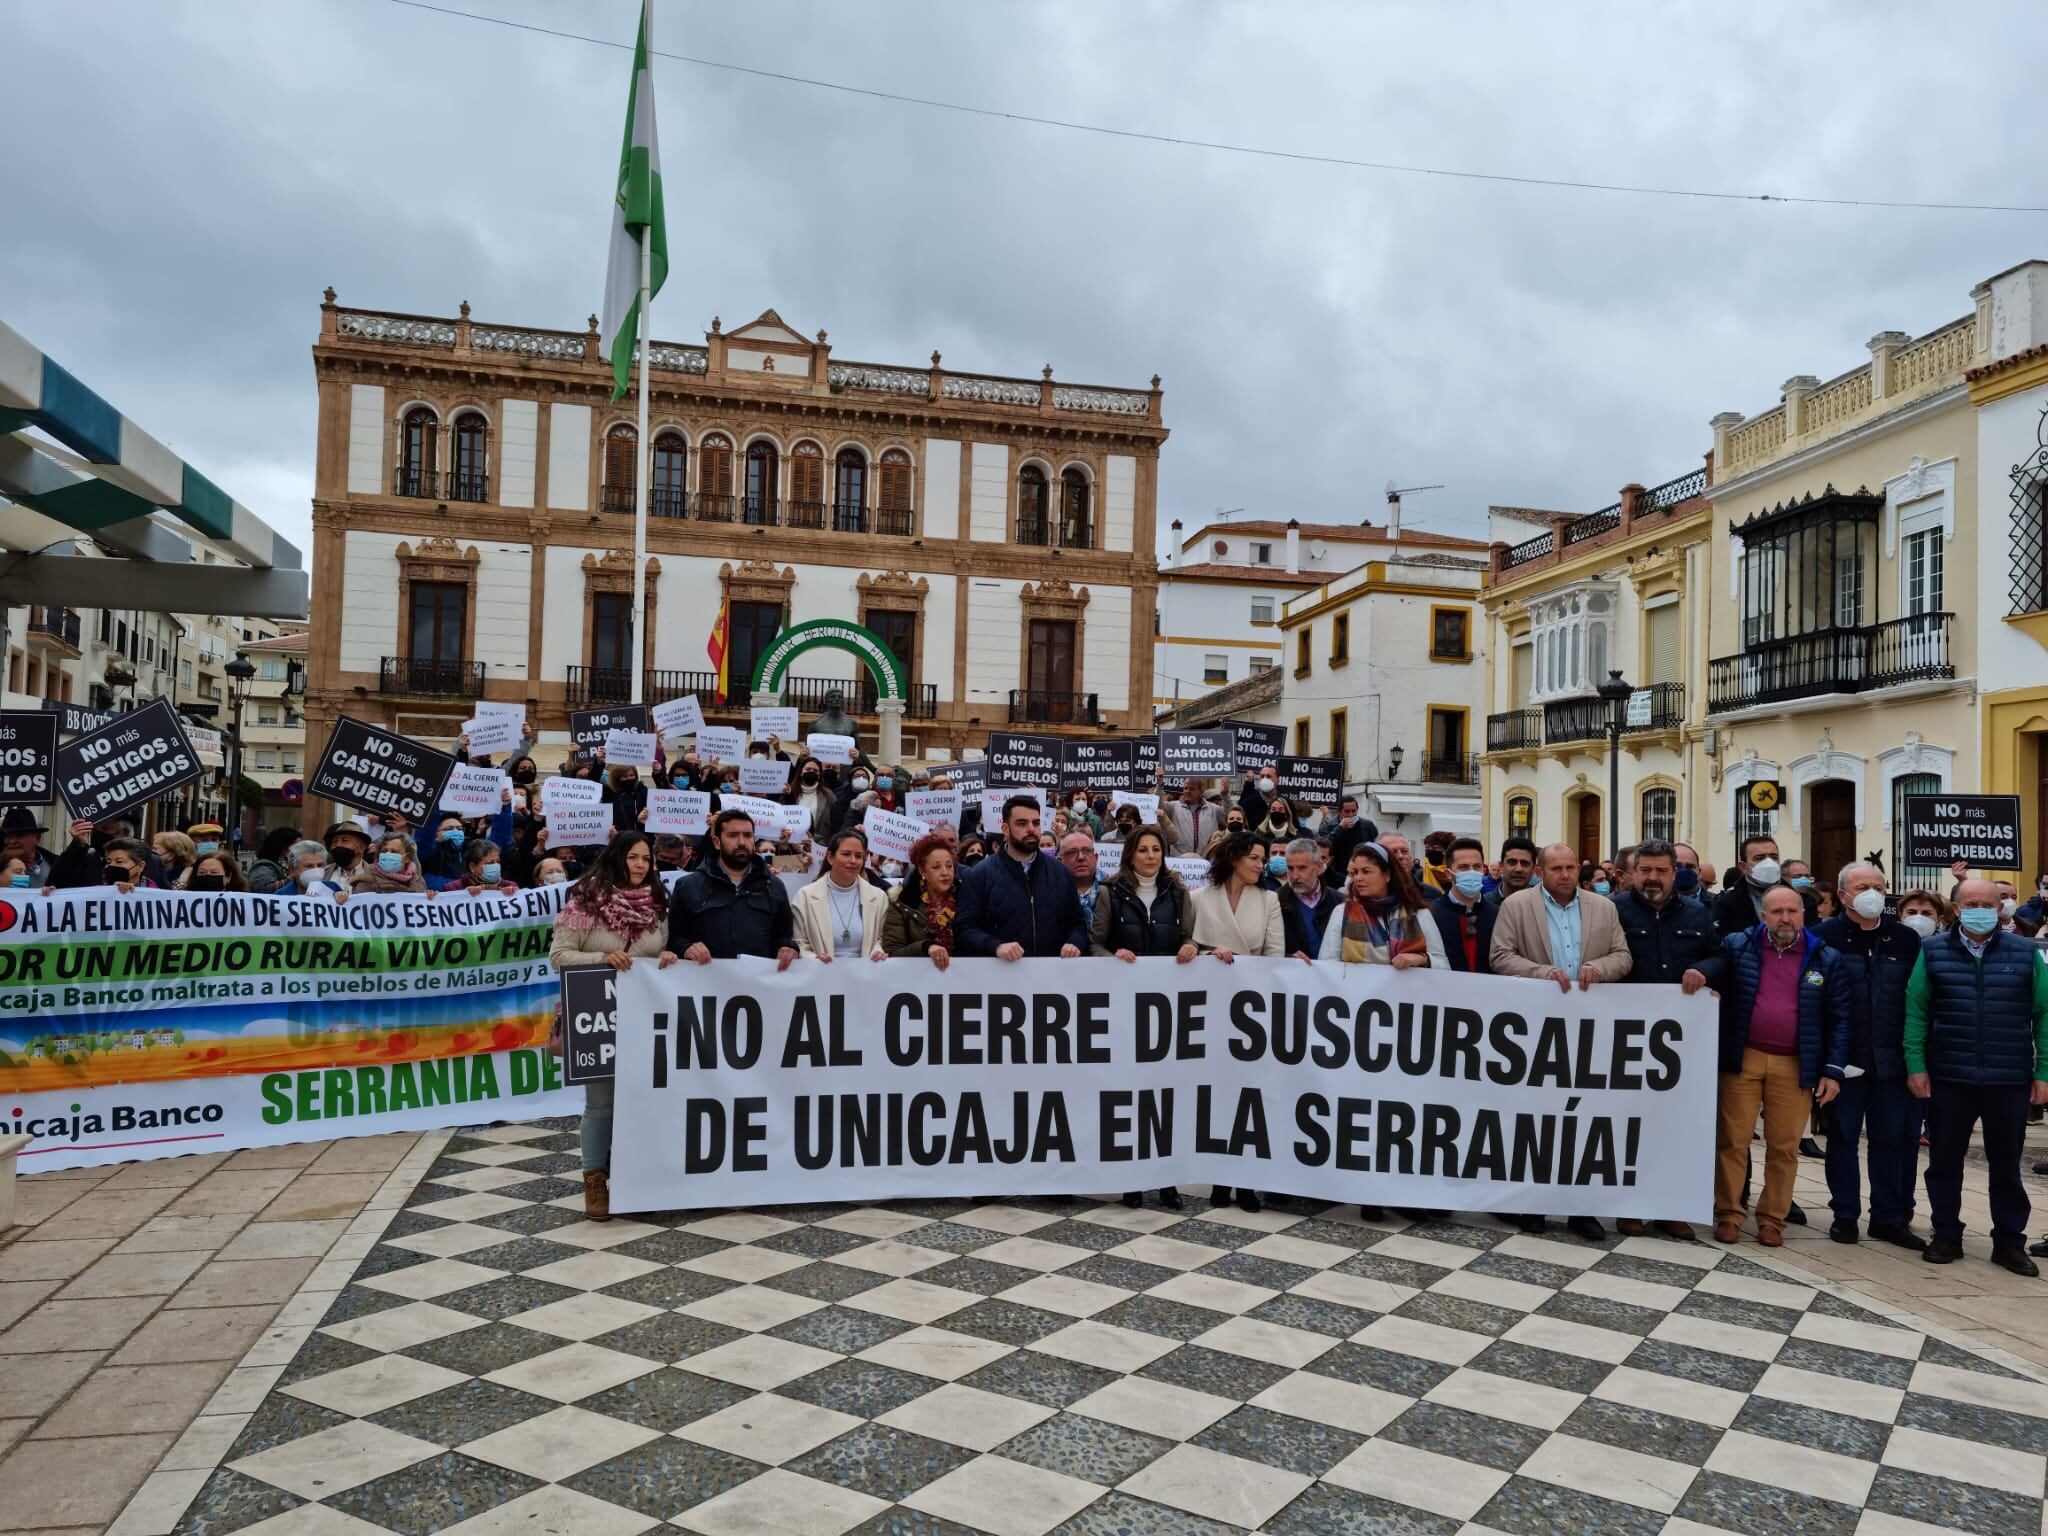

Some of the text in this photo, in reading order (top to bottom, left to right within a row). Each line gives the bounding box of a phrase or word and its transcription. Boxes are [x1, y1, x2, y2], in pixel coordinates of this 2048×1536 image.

[67, 709, 80, 729] BB
[590, 714, 627, 727] NO más
[1179, 735, 1213, 745] NO más
[1238, 727, 1267, 741] NO más
[79, 728, 140, 763] NO más
[363, 736, 418, 768] NO más
[1009, 740, 1043, 752] NO más
[1078, 747, 1112, 757] NO más
[1139, 745, 1156, 756] NO
[1237, 741, 1275, 755] STIGOS
[1165, 748, 1225, 759] CASTIGOS
[41, 755, 48, 767] a
[67, 736, 180, 795] CASTIGOS a
[993, 753, 1053, 769] CASTIGOS
[1063, 761, 1130, 772] INJUSTICIAS
[1164, 763, 1174, 771] los
[1176, 762, 1232, 772] PUEBLOS
[1237, 756, 1276, 768] UEBLOS
[332, 750, 433, 797] CASTIGOS a
[947, 769, 980, 780] NO más
[1293, 762, 1324, 774] NO más
[462, 773, 473, 781] AL
[474, 774, 500, 783] CIERRE
[991, 770, 1058, 784] los PUEBLOS
[1076, 778, 1087, 787] los
[1088, 776, 1130, 787] PUEBLOS
[1136, 775, 1144, 783] los
[1278, 775, 1339, 789] INJUSTICIAS
[79, 754, 190, 818] los PUEBLOS
[462, 785, 495, 793] UNICAJA
[572, 783, 596, 792] CIERRE
[321, 772, 426, 818] los PUEBLOS
[453, 794, 488, 804] IGUALEJA
[562, 793, 593, 801] UNICAJA
[678, 797, 704, 805] CIERRE
[912, 798, 924, 806] NO
[933, 796, 956, 804] CIERRE
[1289, 790, 1337, 802] los PUEBLOS
[578, 810, 606, 818] CIERRE
[668, 807, 700, 815] UNICAJA
[916, 807, 953, 817] DE UNICAJA
[1935, 803, 1986, 818] NO más
[557, 822, 602, 831] DE UNICAJA
[660, 817, 695, 825] IGUALEJA
[873, 813, 921, 834] NO AL CIERRE
[873, 824, 916, 843] DE UNICAJA
[1913, 823, 2014, 839] INJUSTICIAS
[1914, 844, 2014, 860] con los PUEBLOS
[21, 890, 550, 933] A LA ELIMINACIÓN DE SERVICIOS ESENCIALES EN
[56, 946, 116, 980] UN
[122, 941, 252, 976] MEDIO
[259, 939, 377, 970] RURAL
[387, 937, 469, 968] VIVO
[473, 933, 497, 961] Y
[64, 987, 143, 1007] Banco
[151, 980, 254, 1001] maltrata
[260, 983, 273, 995] a
[280, 976, 311, 994] los
[316, 971, 408, 997] pueblos
[414, 970, 441, 989] de
[446, 964, 518, 988] Málaga
[523, 967, 532, 982] y
[538, 964, 548, 976] a
[604, 979, 616, 1000] N
[652, 990, 1683, 1092] ¡NO AL CIERRE DE SUSCURSALES
[576, 1050, 596, 1068] los
[260, 1047, 562, 1126] SERRANIA DE
[111, 1103, 223, 1131] Banco
[685, 1084, 1642, 1187] DE UNICAJA EN LA SERRANÍA!
